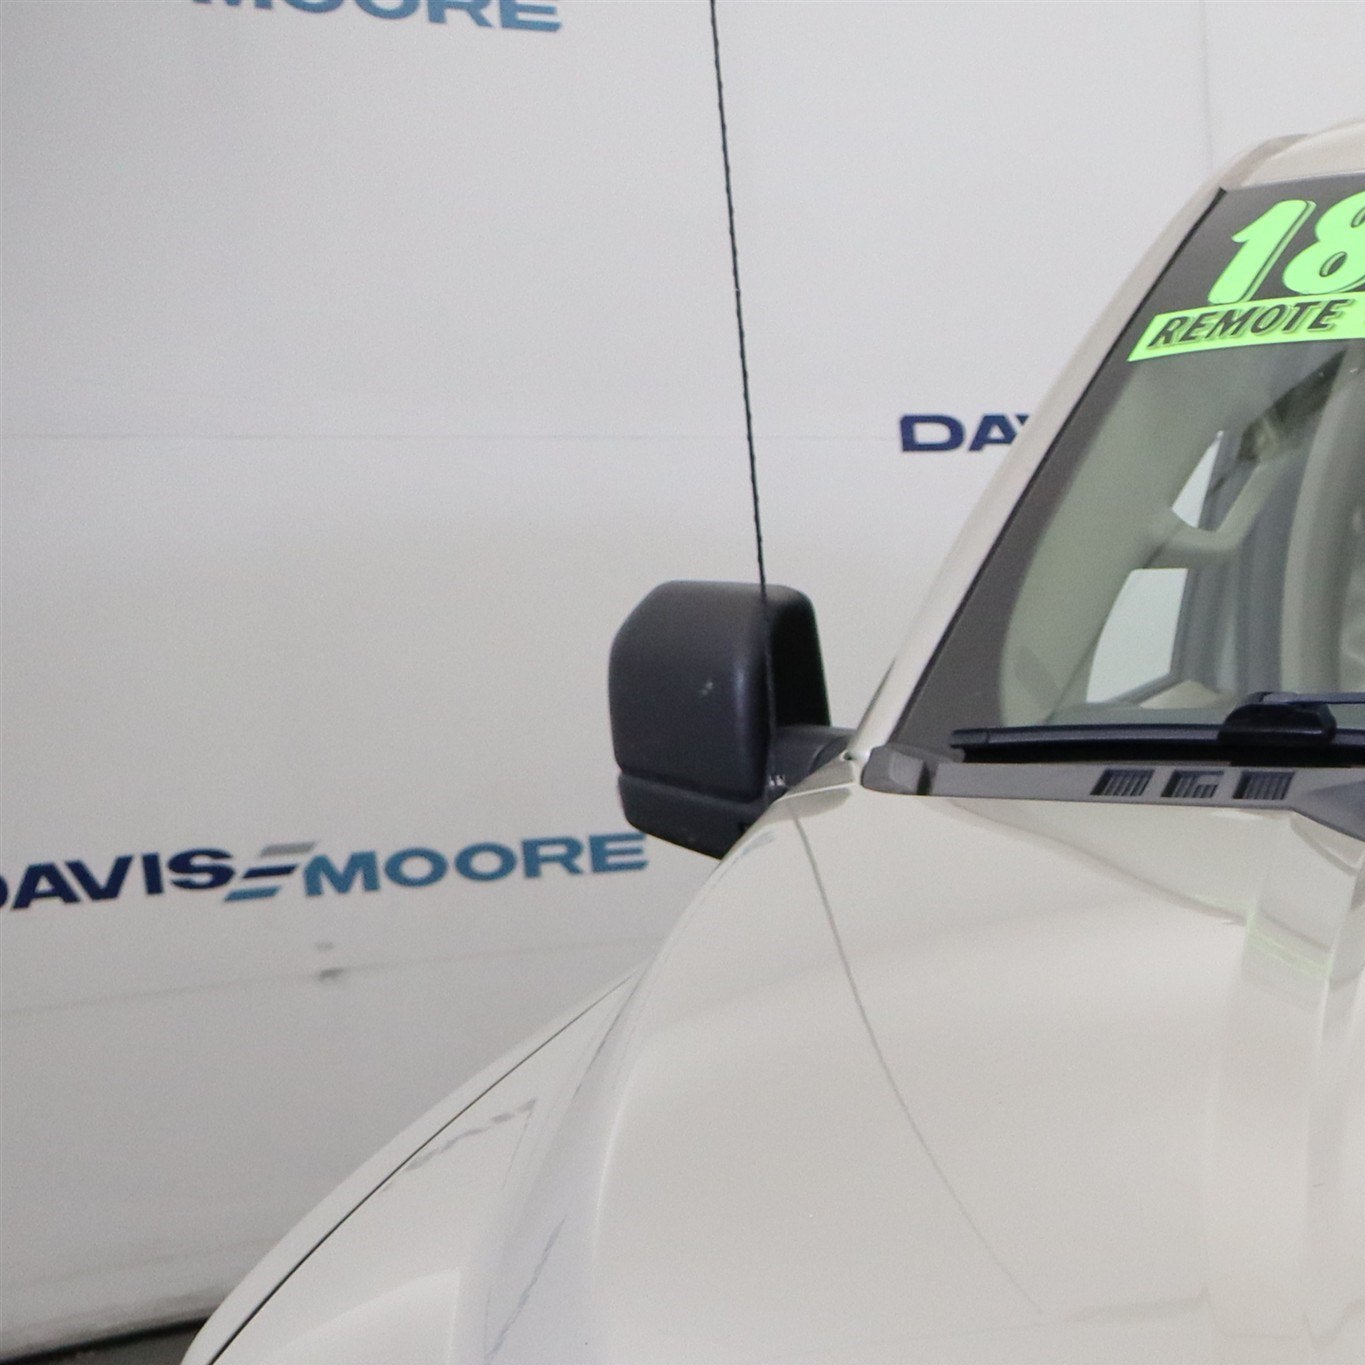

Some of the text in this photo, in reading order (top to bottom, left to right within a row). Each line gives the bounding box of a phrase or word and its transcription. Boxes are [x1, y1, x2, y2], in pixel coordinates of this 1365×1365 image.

[1148, 299, 1356, 350] REMOTE
[900, 414, 1029, 452] DA
[0, 832, 649, 909] AVIS MOORE
